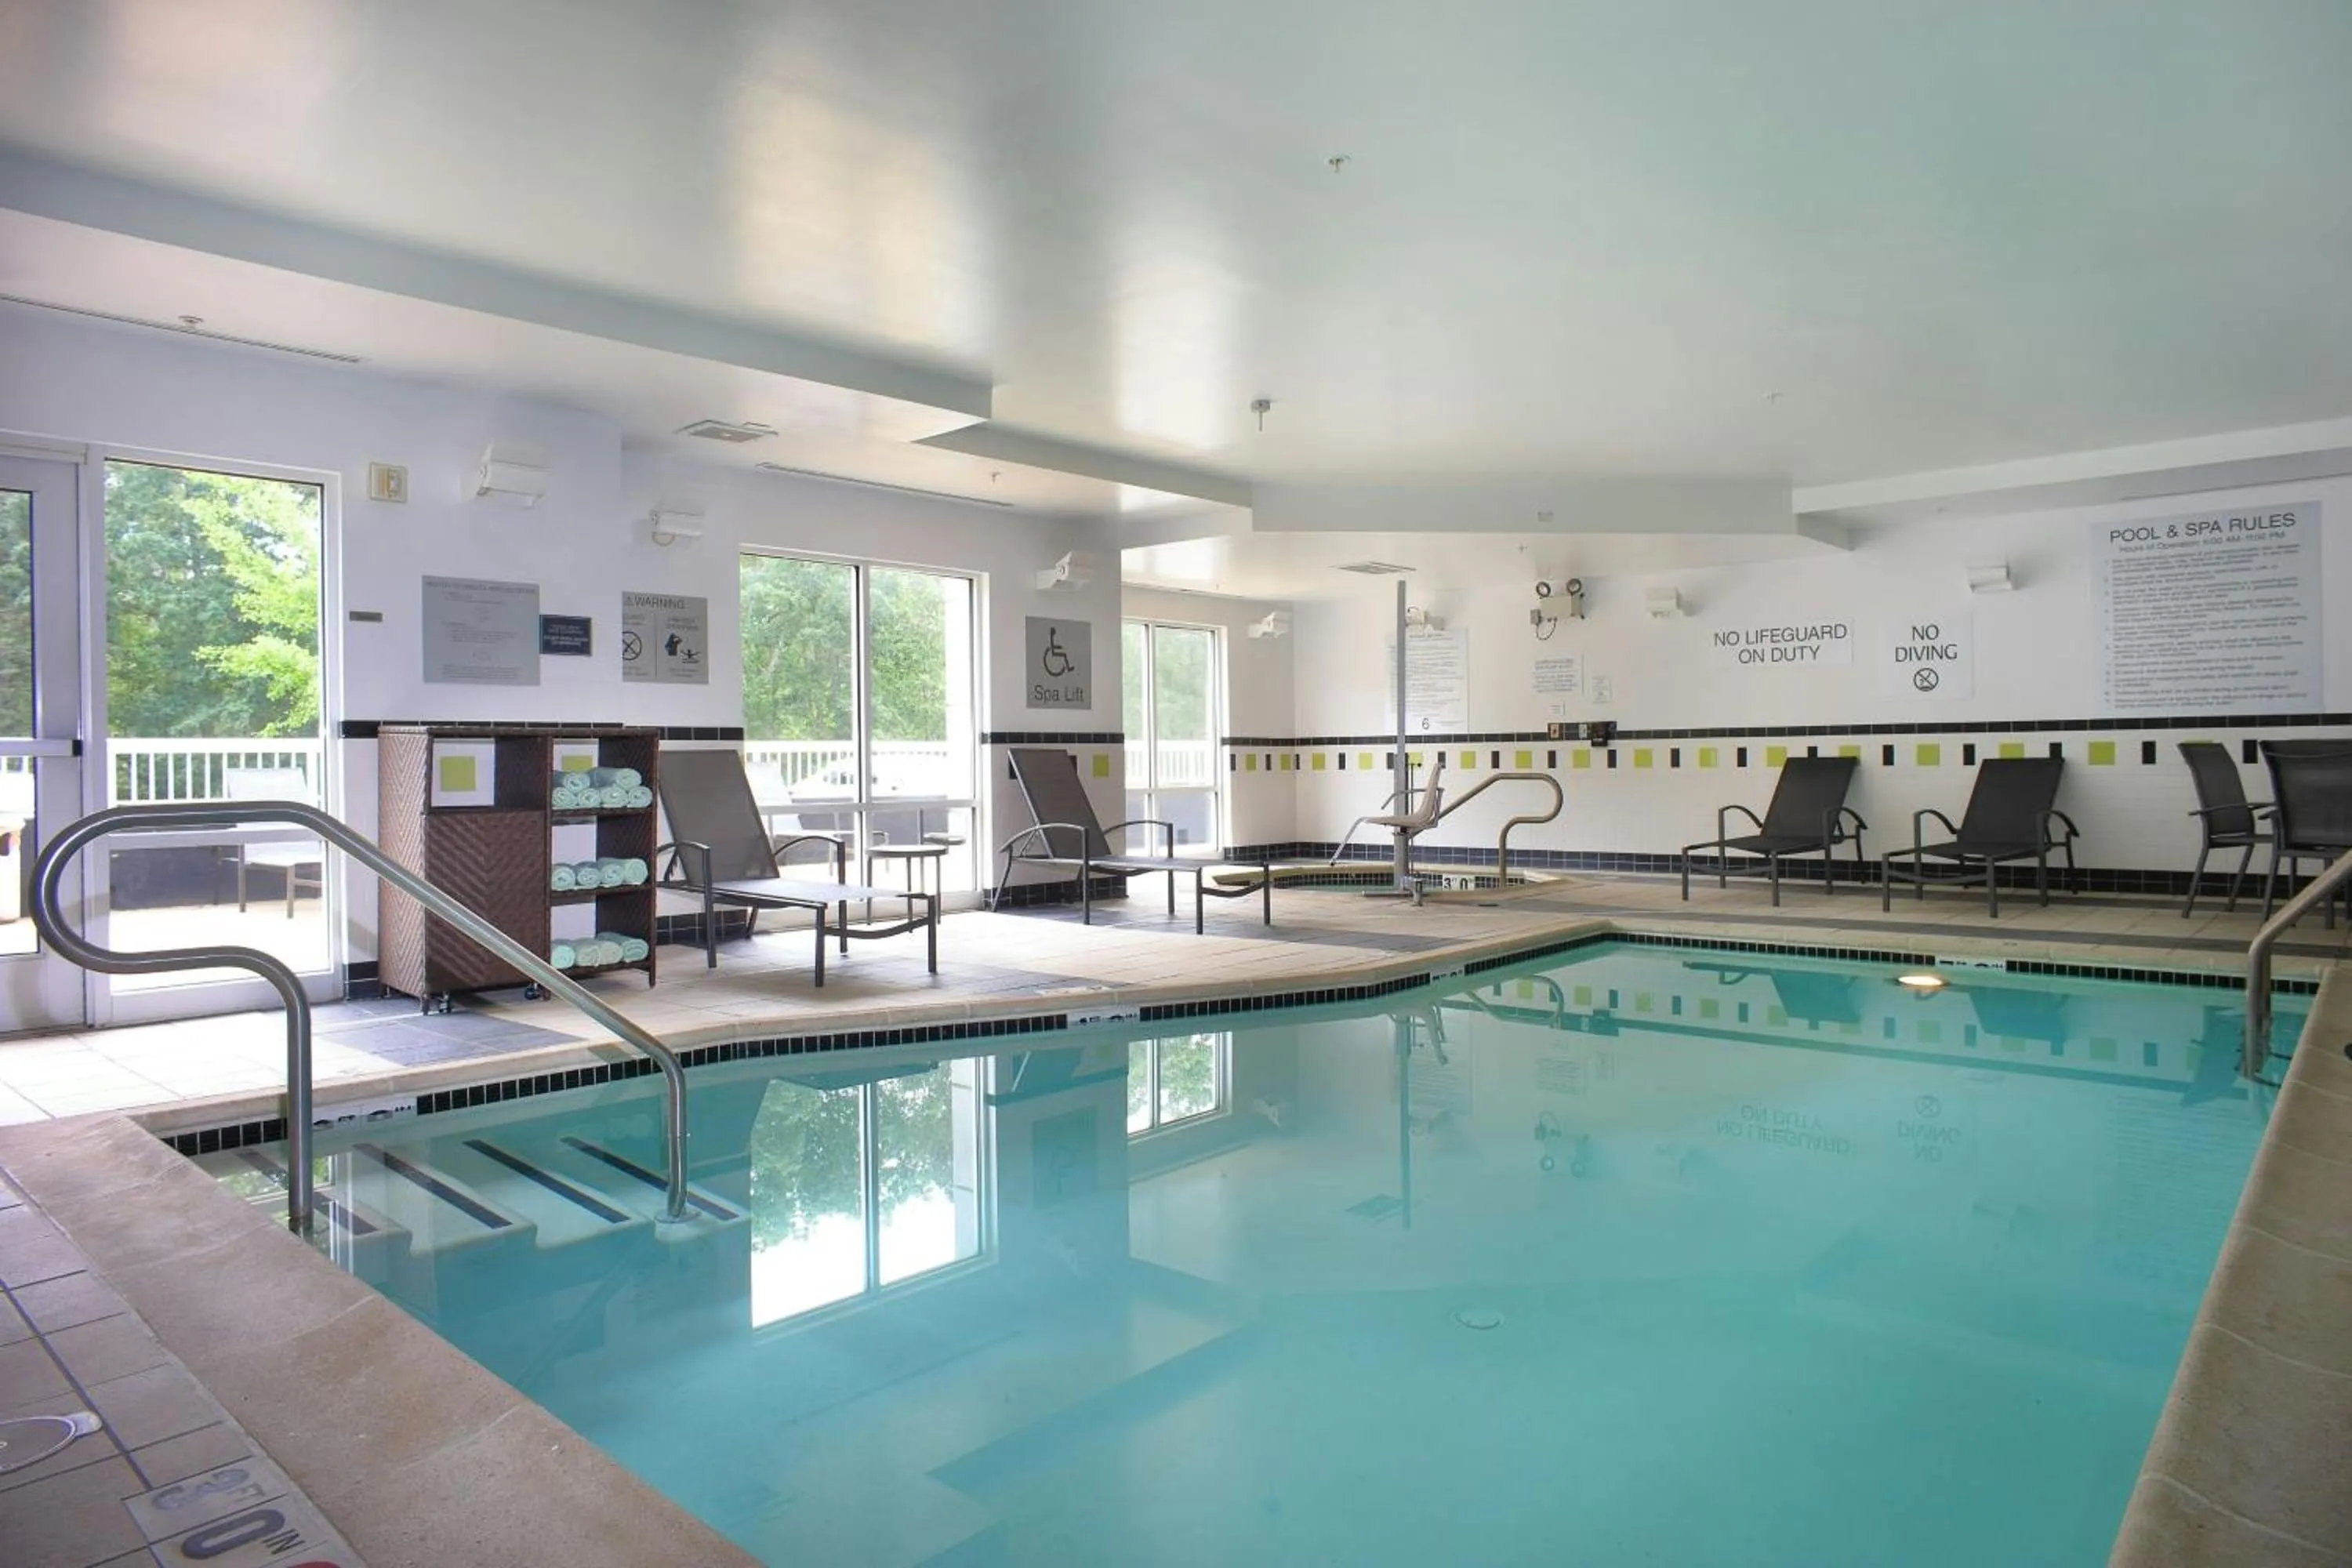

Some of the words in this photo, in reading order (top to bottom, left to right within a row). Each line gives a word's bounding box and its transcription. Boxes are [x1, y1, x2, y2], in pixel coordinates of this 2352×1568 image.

[2110, 527, 2161, 543] POOL
[2167, 525, 2179, 539] &
[2185, 521, 2223, 538] SPA
[2229, 512, 2297, 532] RULES
[1714, 630, 1740, 647] NO
[1745, 623, 1848, 646] LIFEGUARD
[1912, 623, 1940, 641] NO
[1737, 648, 1765, 665] ON
[1770, 644, 1820, 663] DUTY
[1894, 643, 1958, 663] DIVING
[1034, 684, 1060, 703] Spa
[1065, 686, 1084, 702] Lift
[1421, 717, 1430, 730] 6
[1443, 877, 1451, 889] 3
[152, 1468, 250, 1510] 3
[180, 1508, 285, 1560] 0
[261, 1528, 306, 1555] IN
